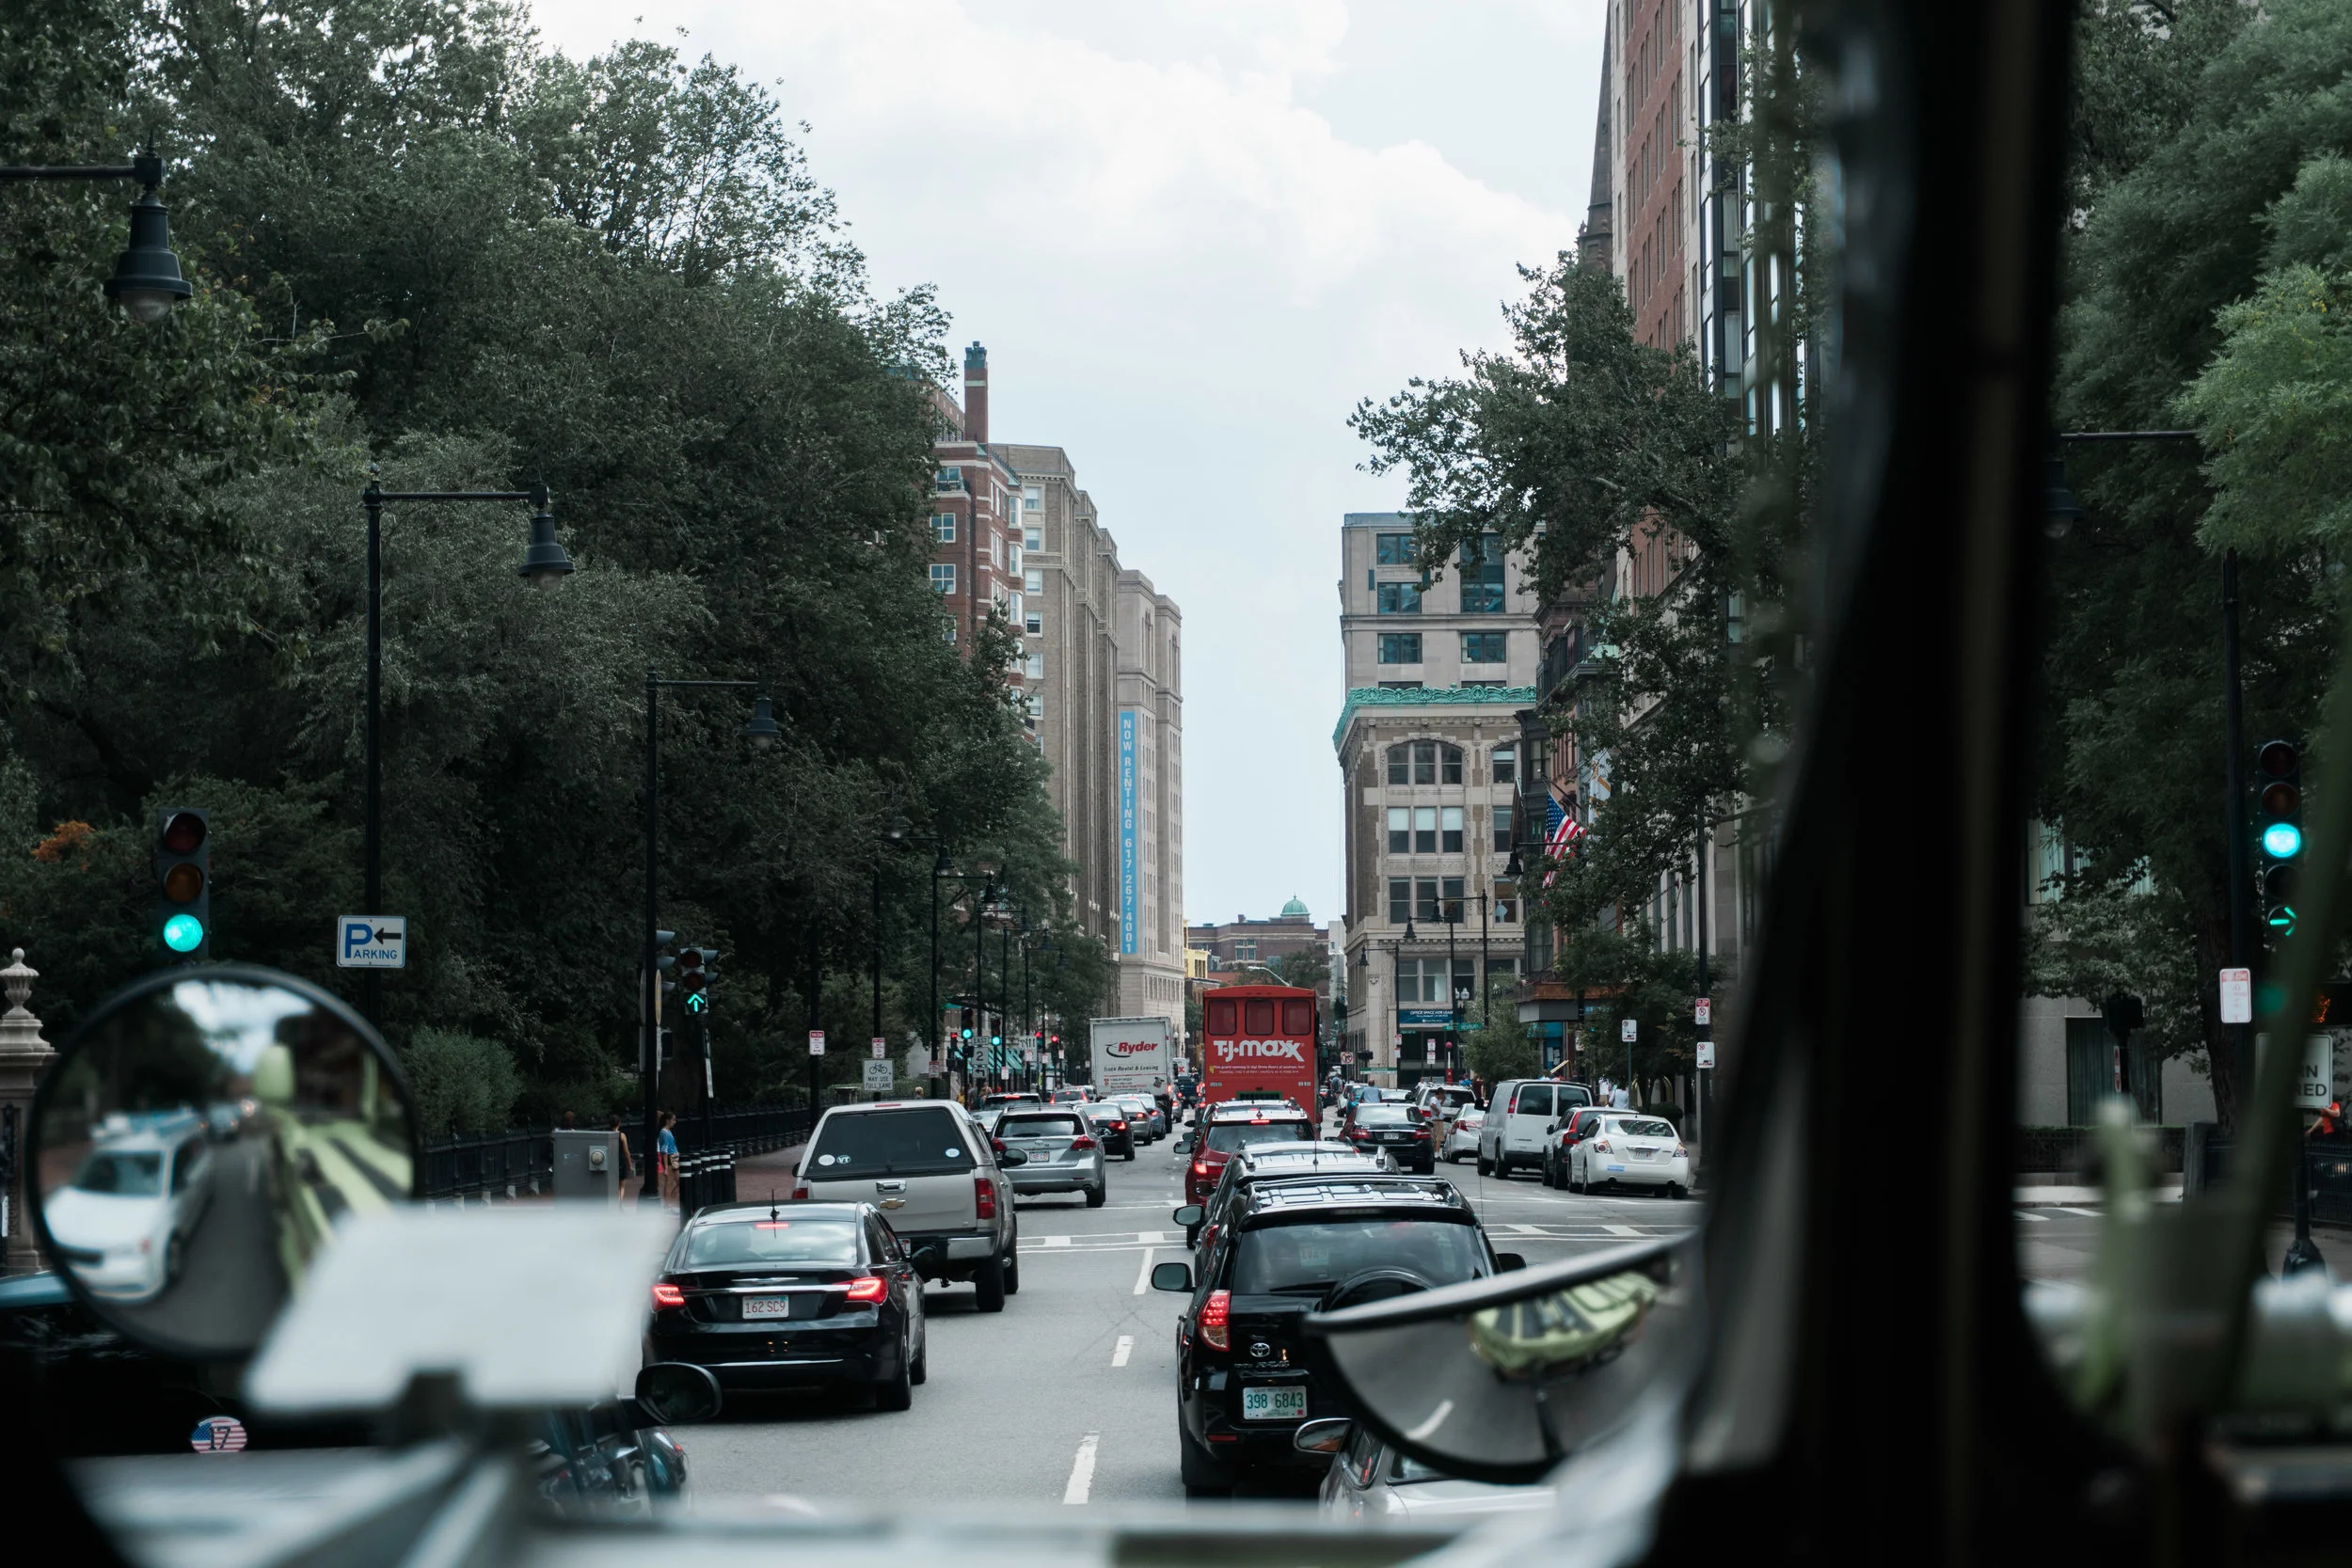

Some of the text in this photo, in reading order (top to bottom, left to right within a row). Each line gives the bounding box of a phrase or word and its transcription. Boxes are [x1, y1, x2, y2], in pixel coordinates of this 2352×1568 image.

[1122, 719, 1133, 752] NOW
[1123, 756, 1133, 830] RENTING
[1118, 1040, 1158, 1054] Ryder
[976, 1051, 984, 1062] 2
[745, 1300, 787, 1314] 162 SC9
[1246, 1391, 1304, 1409] 398 6843
[207, 1425, 231, 1451] 17
